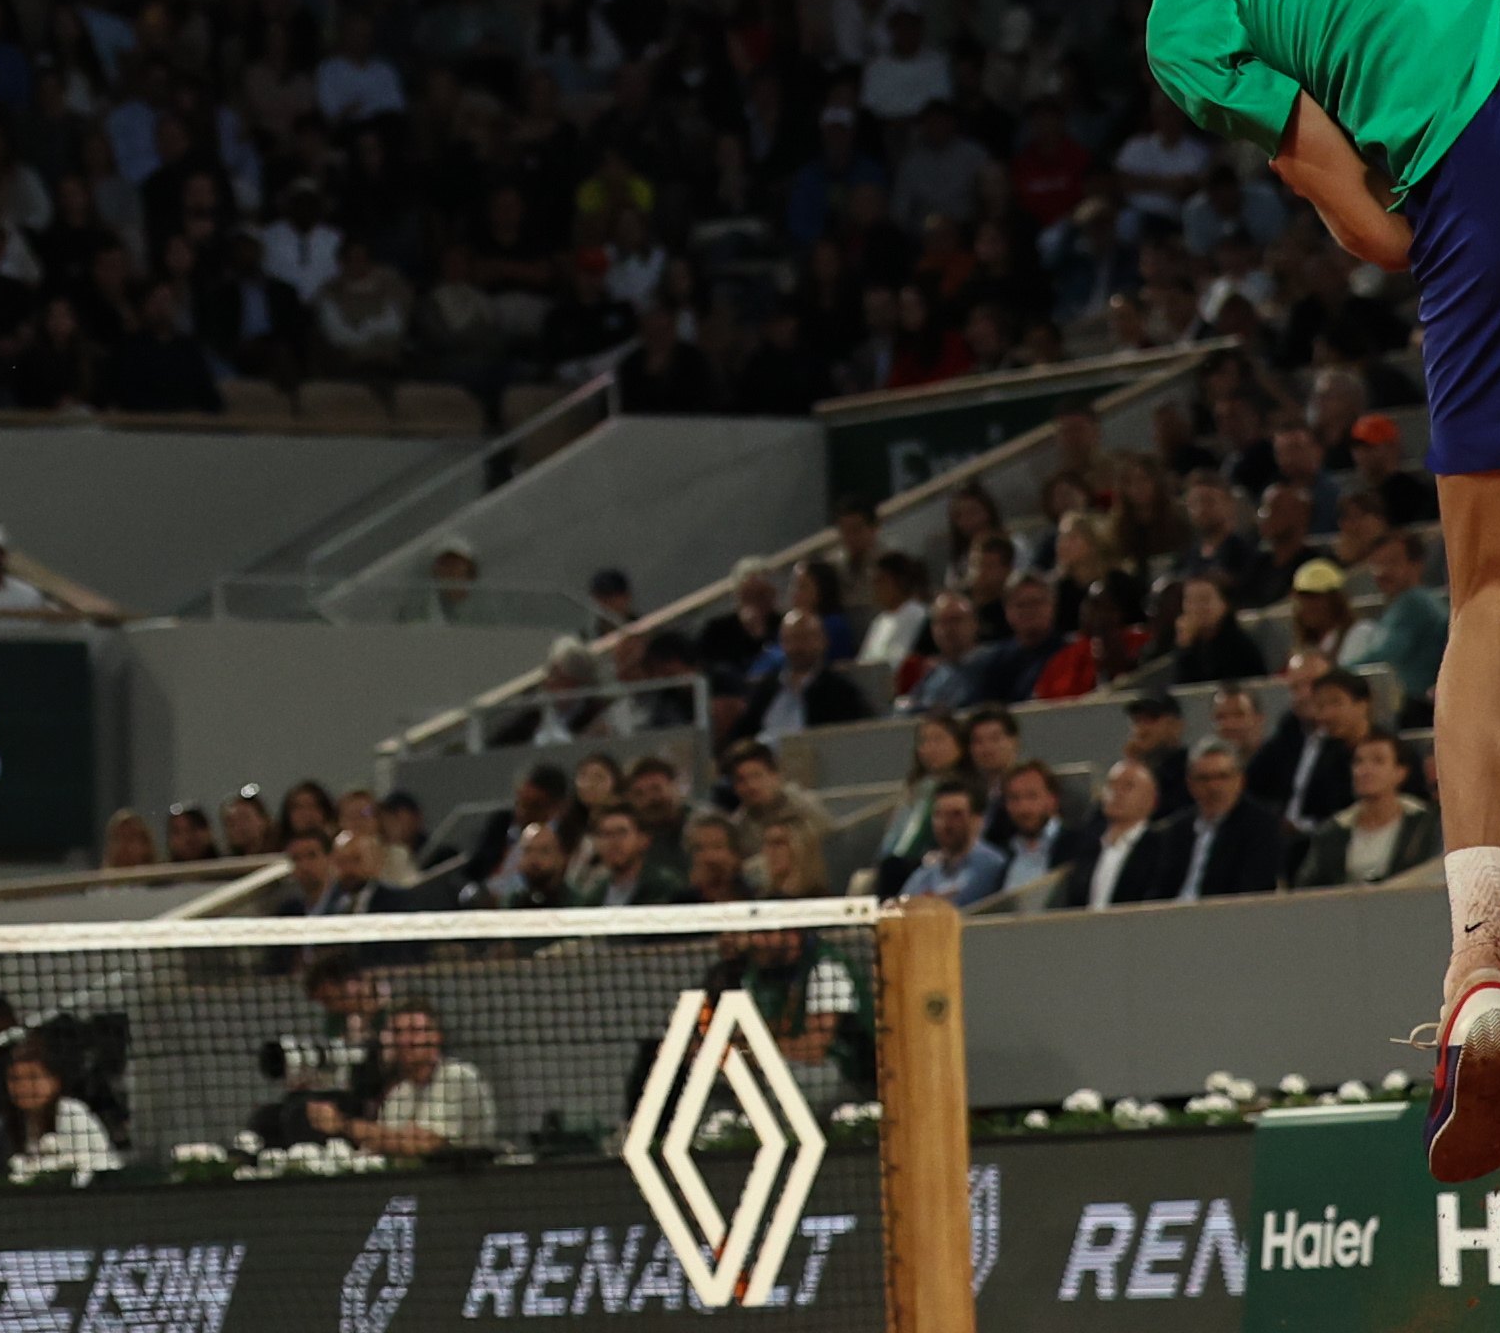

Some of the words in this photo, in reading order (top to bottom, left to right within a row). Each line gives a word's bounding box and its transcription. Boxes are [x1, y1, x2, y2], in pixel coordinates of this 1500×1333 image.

[461, 1214, 857, 1319] RENAT
[1057, 1197, 1249, 1302] REN
[1261, 1204, 1380, 1271] Haier
